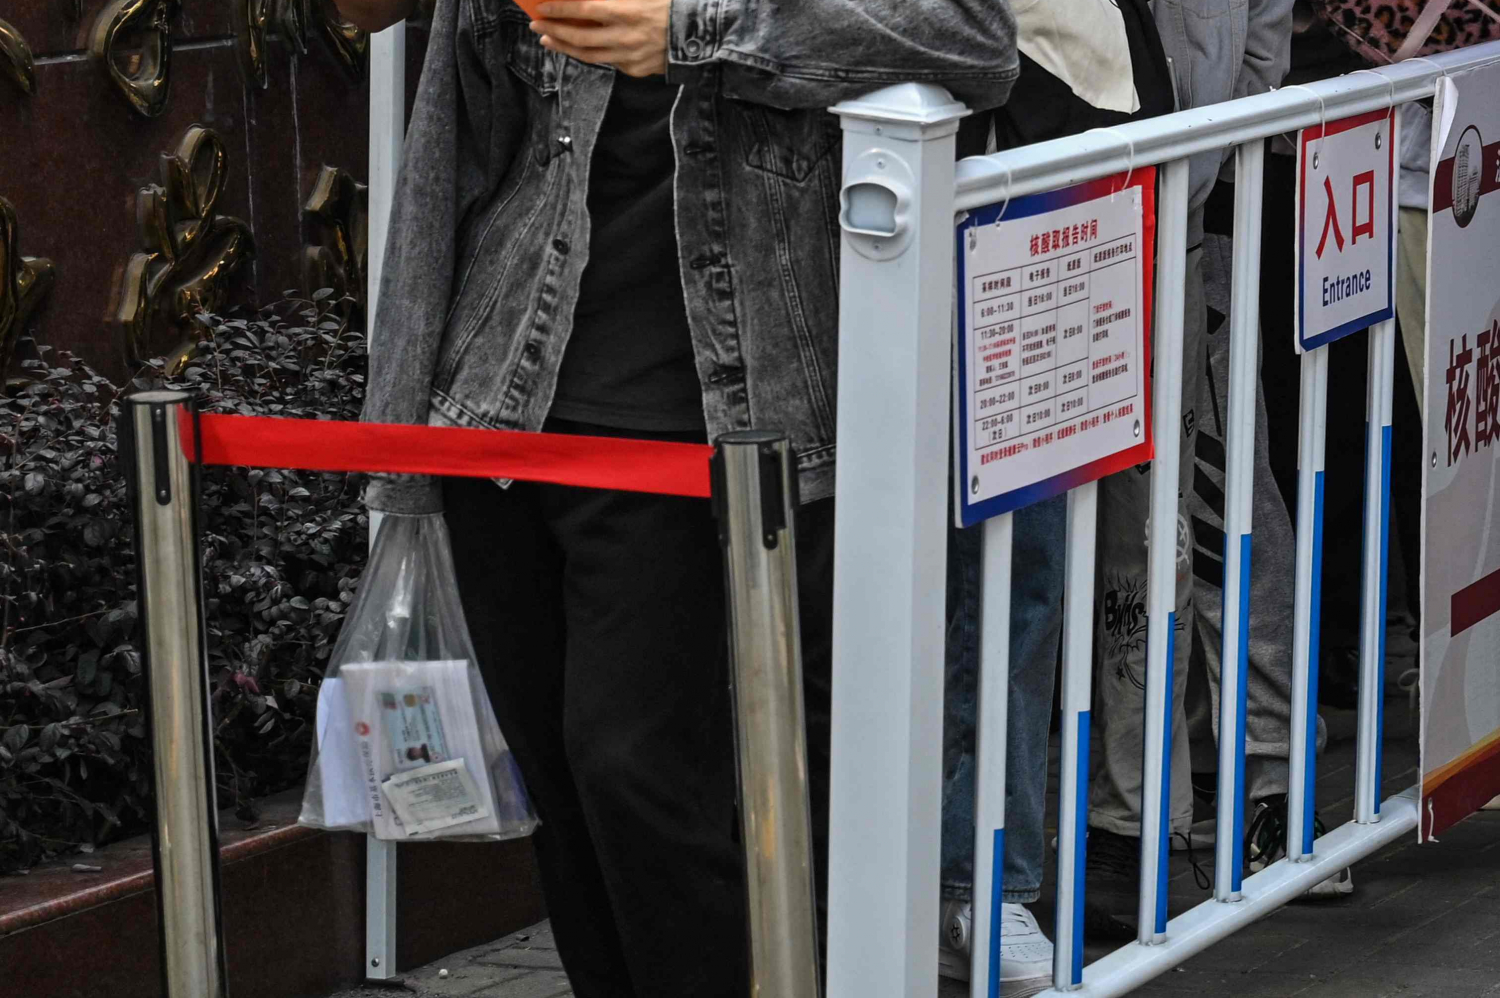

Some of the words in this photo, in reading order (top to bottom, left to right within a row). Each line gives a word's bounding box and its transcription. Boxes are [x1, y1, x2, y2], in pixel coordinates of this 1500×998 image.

[1315, 169, 1375, 260] 入口
[1028, 218, 1099, 258] 核酸取报告时间
[1028, 268, 1051, 282] 电子报告
[1322, 269, 1371, 307] Entrance
